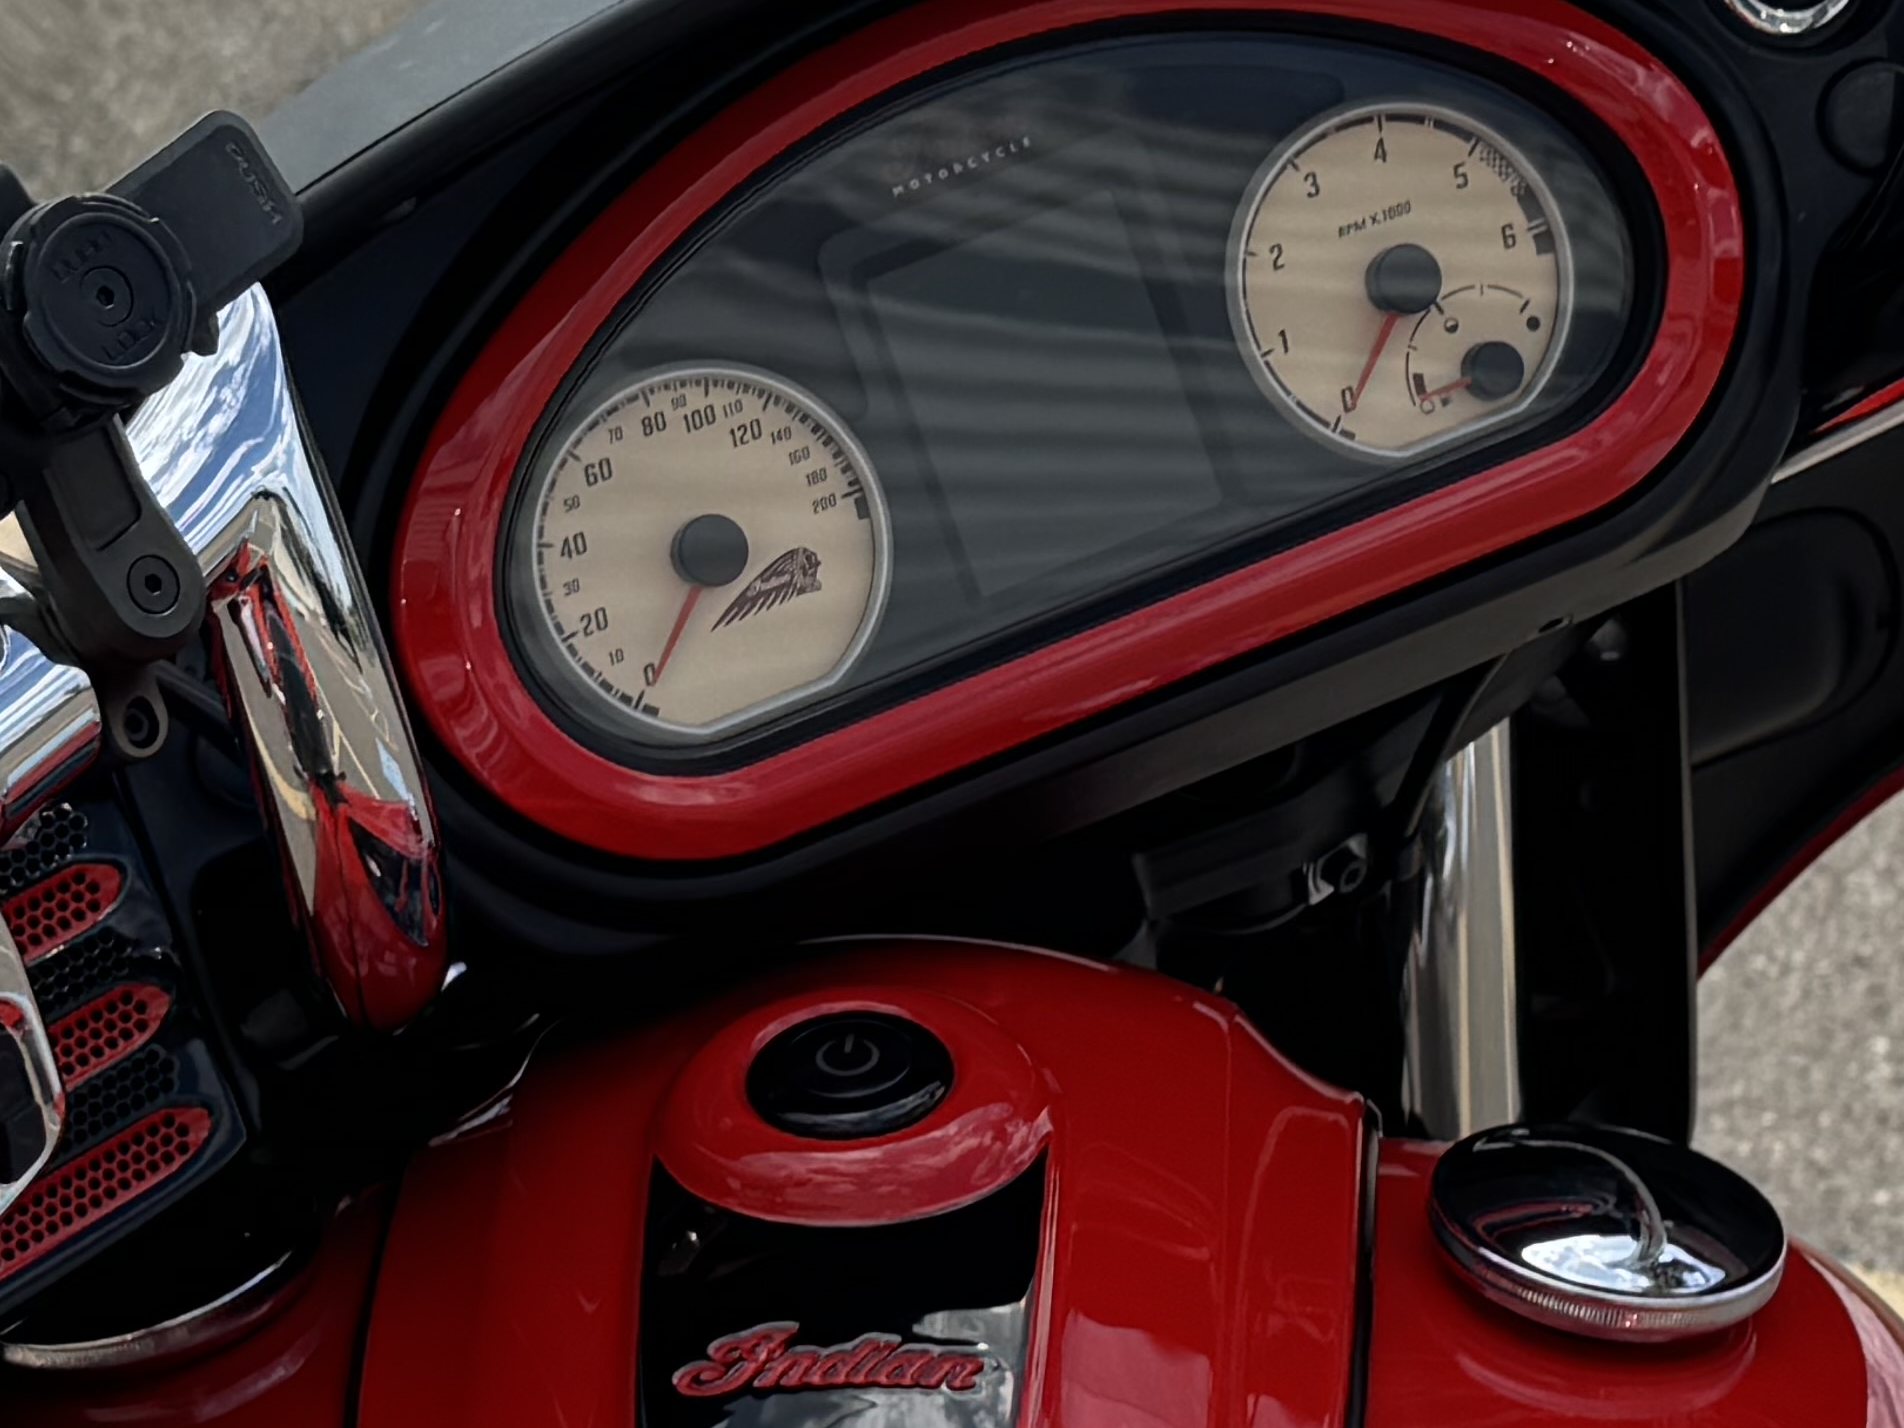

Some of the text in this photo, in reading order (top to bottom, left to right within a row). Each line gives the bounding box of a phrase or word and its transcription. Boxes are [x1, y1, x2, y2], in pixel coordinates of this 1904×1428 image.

[1374, 137, 1387, 164] 4
[892, 135, 1031, 198] MOTORCYCLE
[1453, 161, 1469, 189] 5
[1304, 172, 1320, 198] 3
[1381, 199, 1411, 223] 1000
[1501, 223, 1517, 250] 6
[1269, 243, 1285, 271] 2
[1278, 329, 1289, 354] 1
[723, 399, 743, 419] 110
[1341, 386, 1356, 413] 0
[641, 411, 667, 437] 80
[684, 404, 716, 433] 100
[608, 426, 623, 444] 70
[729, 418, 762, 448] 120
[584, 457, 613, 488] 60
[563, 495, 581, 513] 50
[560, 531, 587, 560] 40
[562, 578, 581, 597] 30
[579, 606, 609, 637] 20
[609, 648, 624, 666] 10
[643, 662, 657, 687] 0
[672, 1321, 986, 1397] Indian
